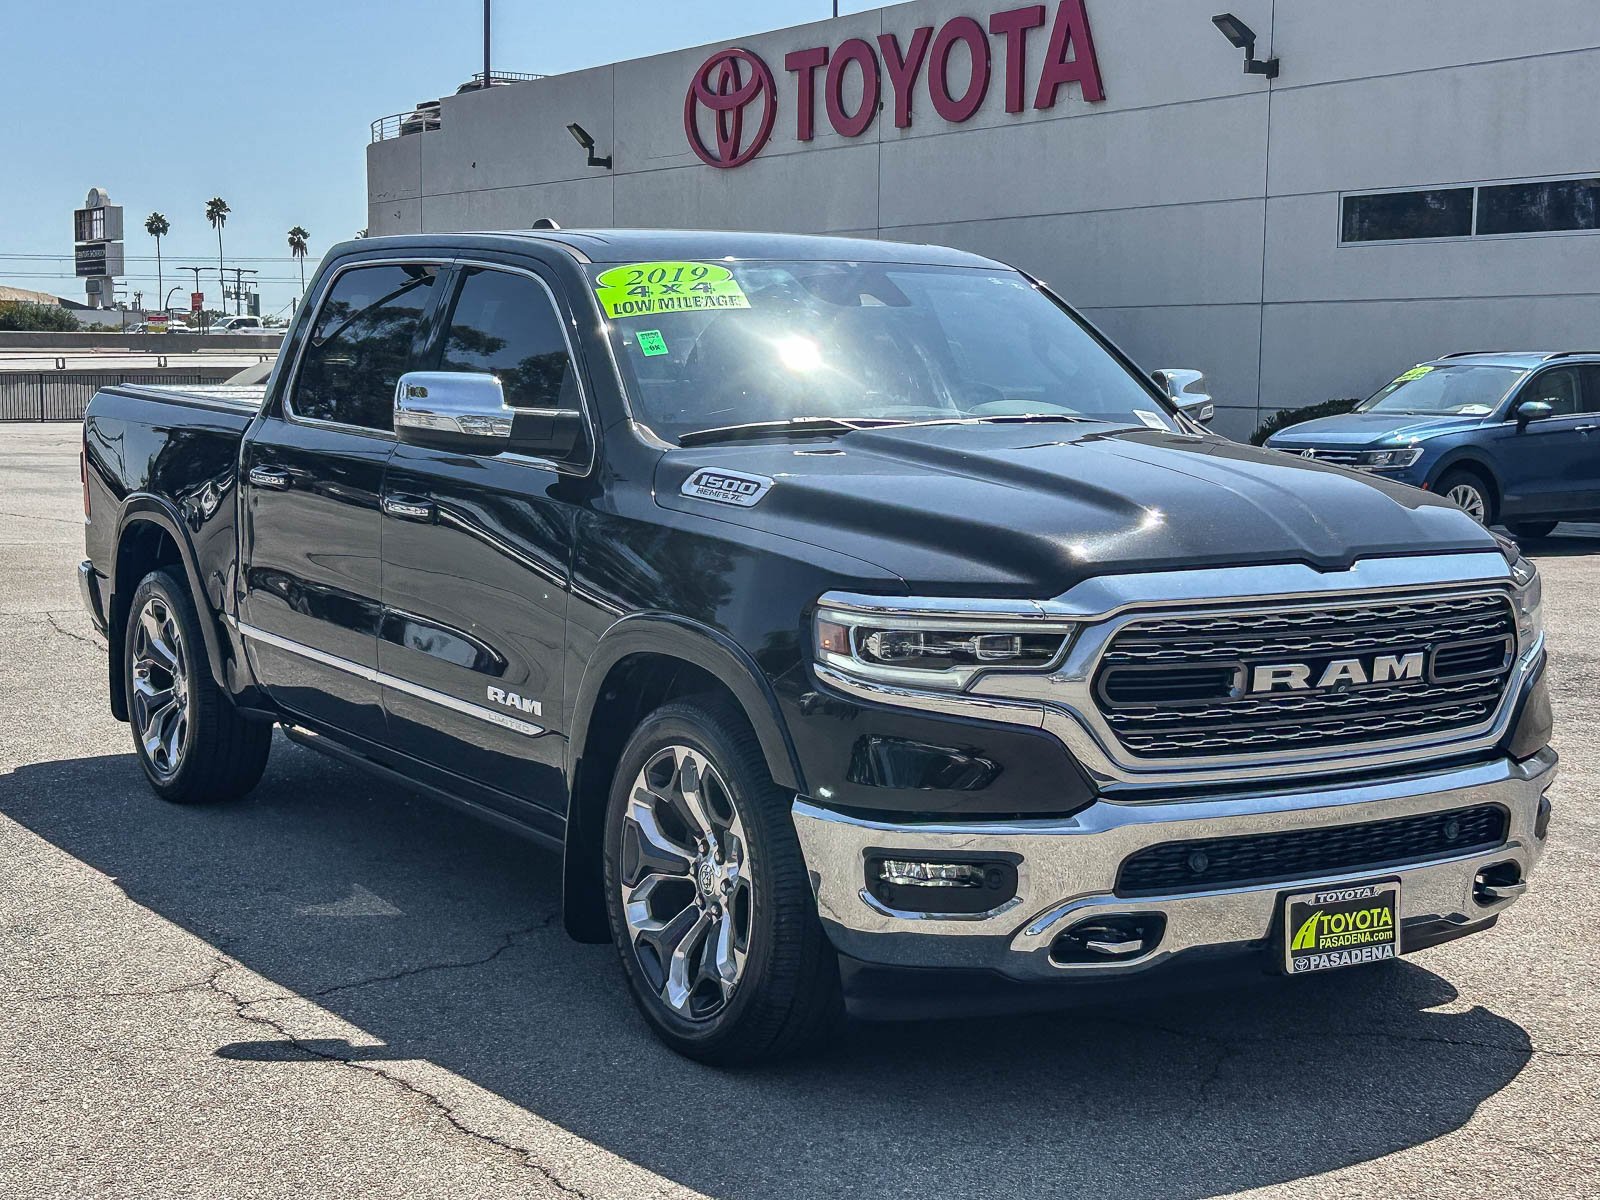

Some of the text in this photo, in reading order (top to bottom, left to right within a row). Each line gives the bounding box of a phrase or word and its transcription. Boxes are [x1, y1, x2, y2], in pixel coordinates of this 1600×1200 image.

[785, 0, 1106, 141] TOYOTA
[626, 266, 708, 286] 2019
[613, 296, 741, 315] LOW MILEAGE
[699, 474, 757, 495] 1500
[1252, 652, 1424, 692] RAM
[487, 685, 542, 717] RAM
[1317, 887, 1372, 903] TOYOTA
[1320, 907, 1392, 934] TOYOTA
[1319, 930, 1393, 950] PASADENA.com
[1310, 946, 1394, 969] PASADENA
